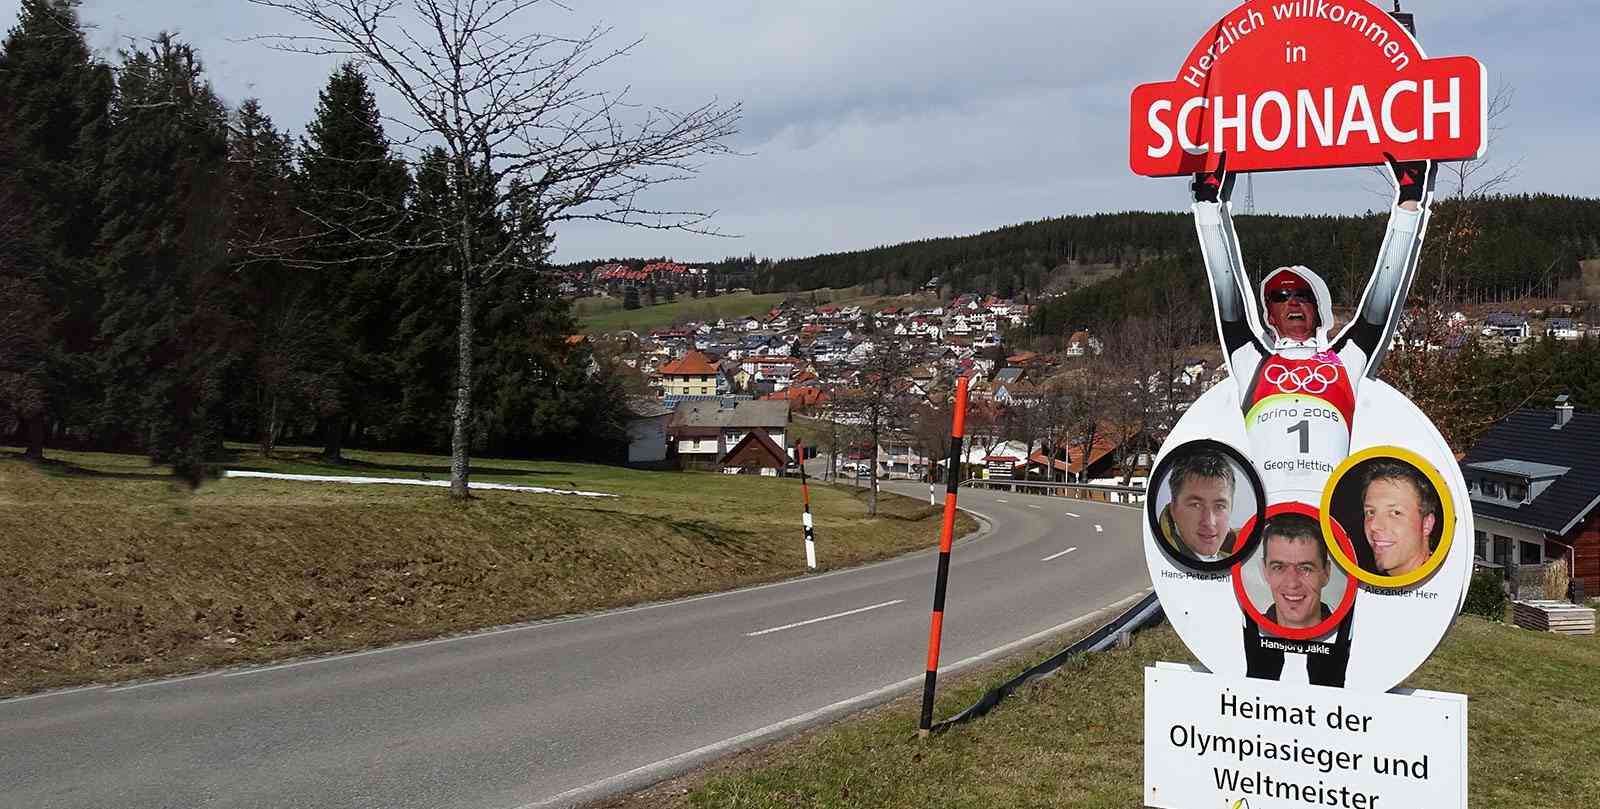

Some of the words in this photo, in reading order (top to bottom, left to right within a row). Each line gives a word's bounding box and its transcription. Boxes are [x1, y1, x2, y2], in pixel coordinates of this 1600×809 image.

[1183, 9, 1265, 88] Herzlich
[1272, 0, 1410, 72] willkommen
[1285, 41, 1307, 63] in
[1147, 77, 1462, 158] SCHONACH
[1303, 408, 1339, 423] 2006
[1287, 420, 1309, 453] 1
[1264, 460, 1294, 471] Georg
[1297, 459, 1334, 473] Hettich
[1161, 570, 1208, 580] Hans-Peter
[1365, 586, 1413, 597] Alexander
[1416, 589, 1438, 599] Herr
[1220, 694, 1316, 727] Heimat
[1326, 706, 1373, 732] der
[1170, 725, 1363, 772] Olympiasieger
[1374, 755, 1429, 779] und
[1214, 767, 1380, 809] Weltmeister
